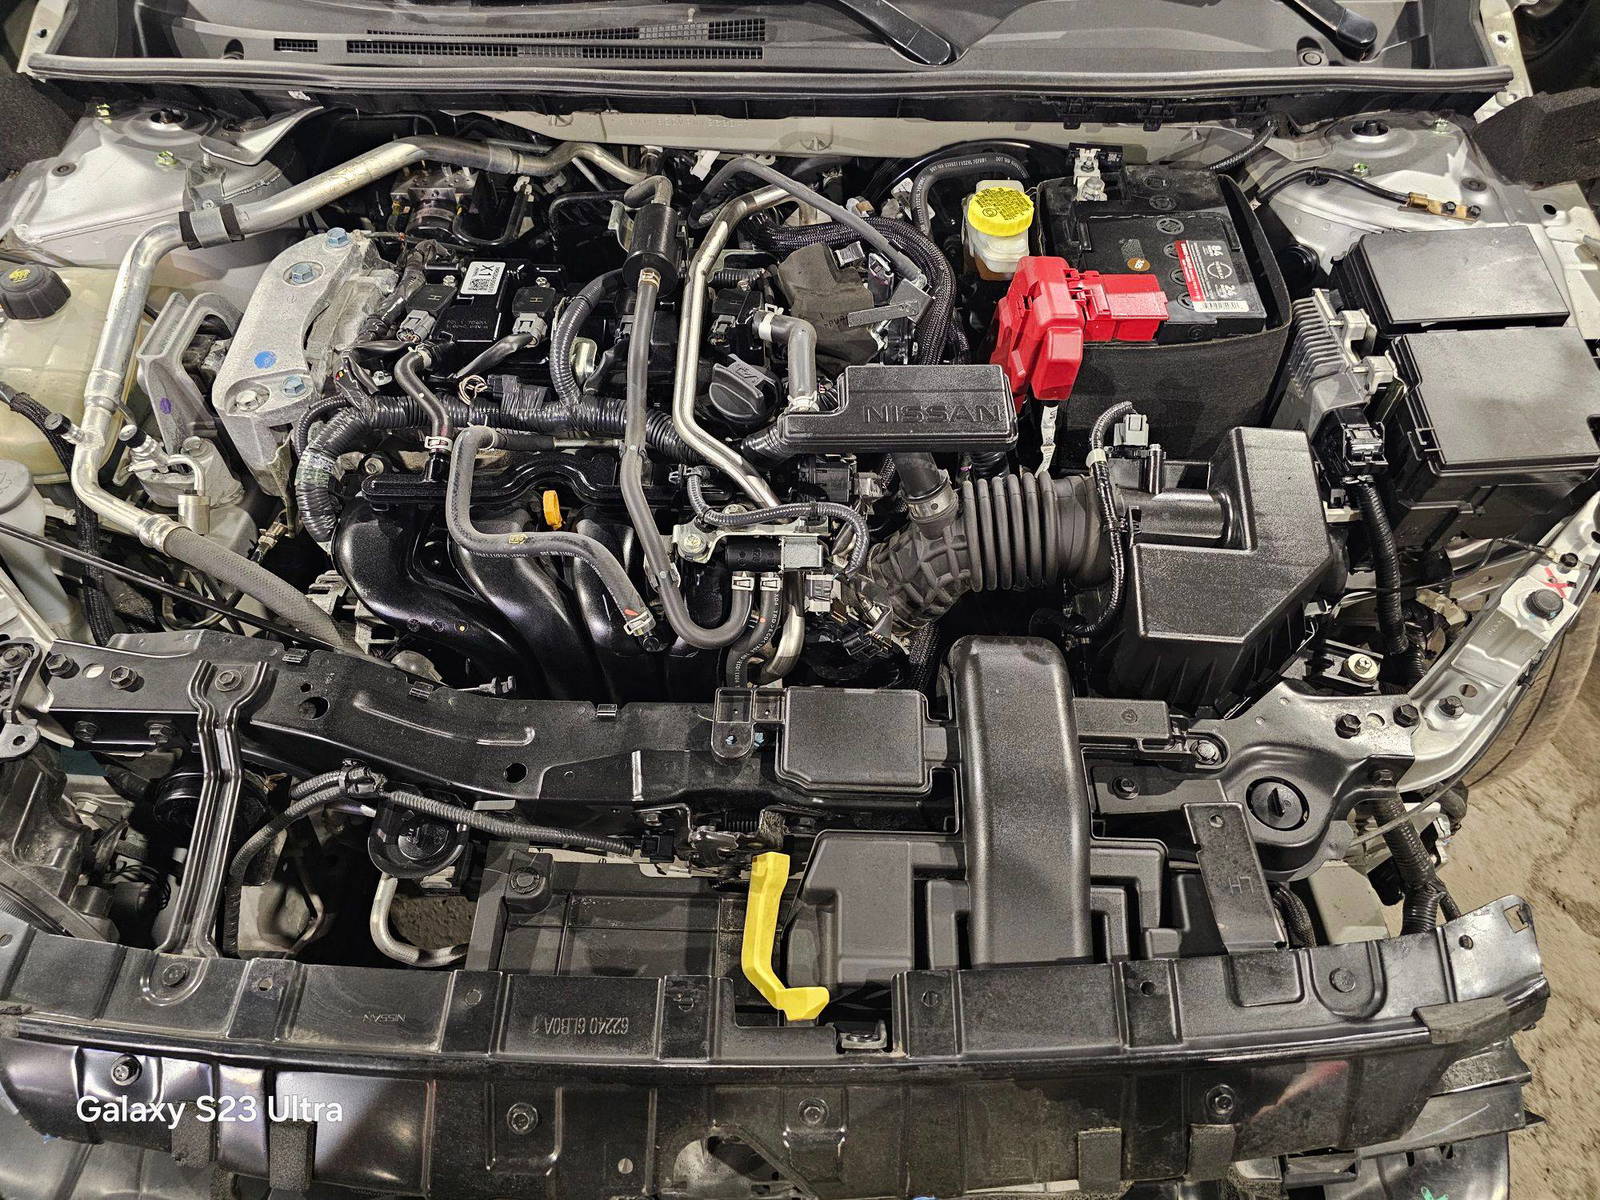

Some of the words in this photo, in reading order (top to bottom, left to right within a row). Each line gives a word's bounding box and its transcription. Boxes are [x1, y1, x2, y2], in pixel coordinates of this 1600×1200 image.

[479, 264, 494, 276] X1
[862, 405, 1001, 423] NISSAN
[362, 1013, 406, 1023] NISSAN
[589, 1016, 629, 1035] 62240
